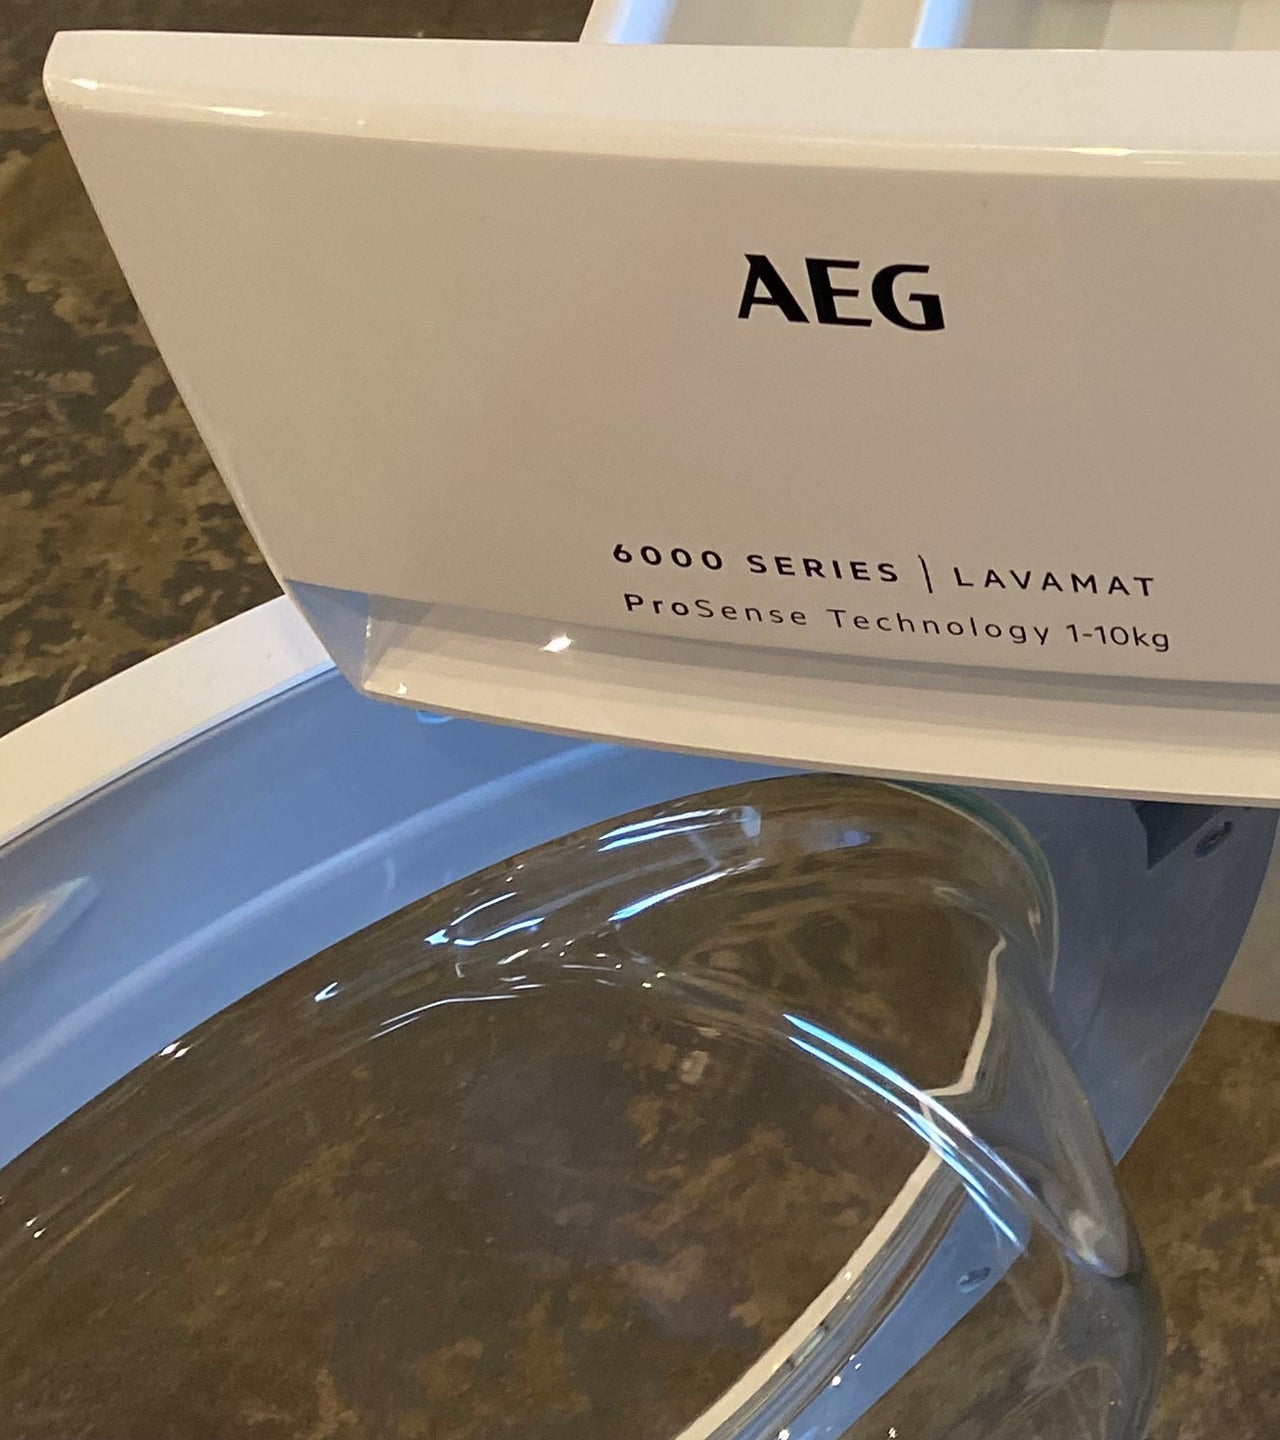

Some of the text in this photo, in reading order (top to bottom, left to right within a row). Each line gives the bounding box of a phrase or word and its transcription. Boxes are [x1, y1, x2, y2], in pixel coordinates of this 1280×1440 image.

[737, 253, 946, 332] AEG
[612, 543, 1154, 597] 6000 SERIES LAVAMAT
[623, 593, 1169, 653] ProSense Technology 1-10kg
